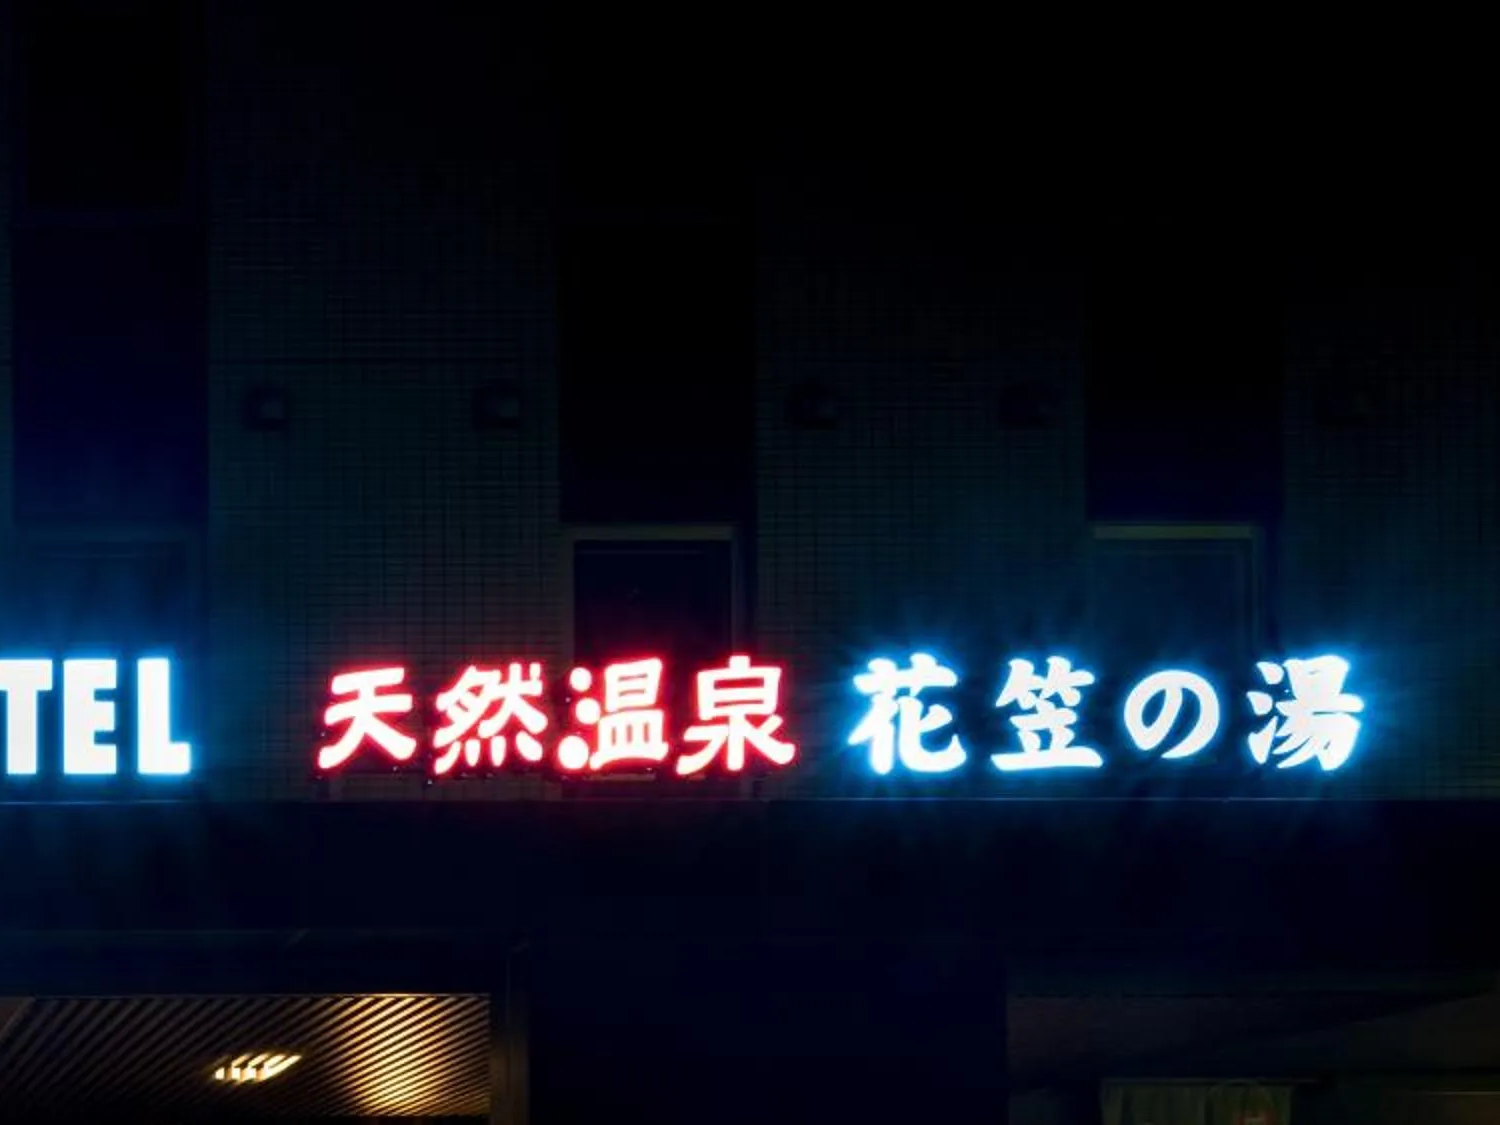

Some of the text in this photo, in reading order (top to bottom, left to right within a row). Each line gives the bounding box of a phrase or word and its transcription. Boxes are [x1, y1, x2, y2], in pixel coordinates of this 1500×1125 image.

[315, 653, 1366, 777] 天然温泉 花笠の湯
